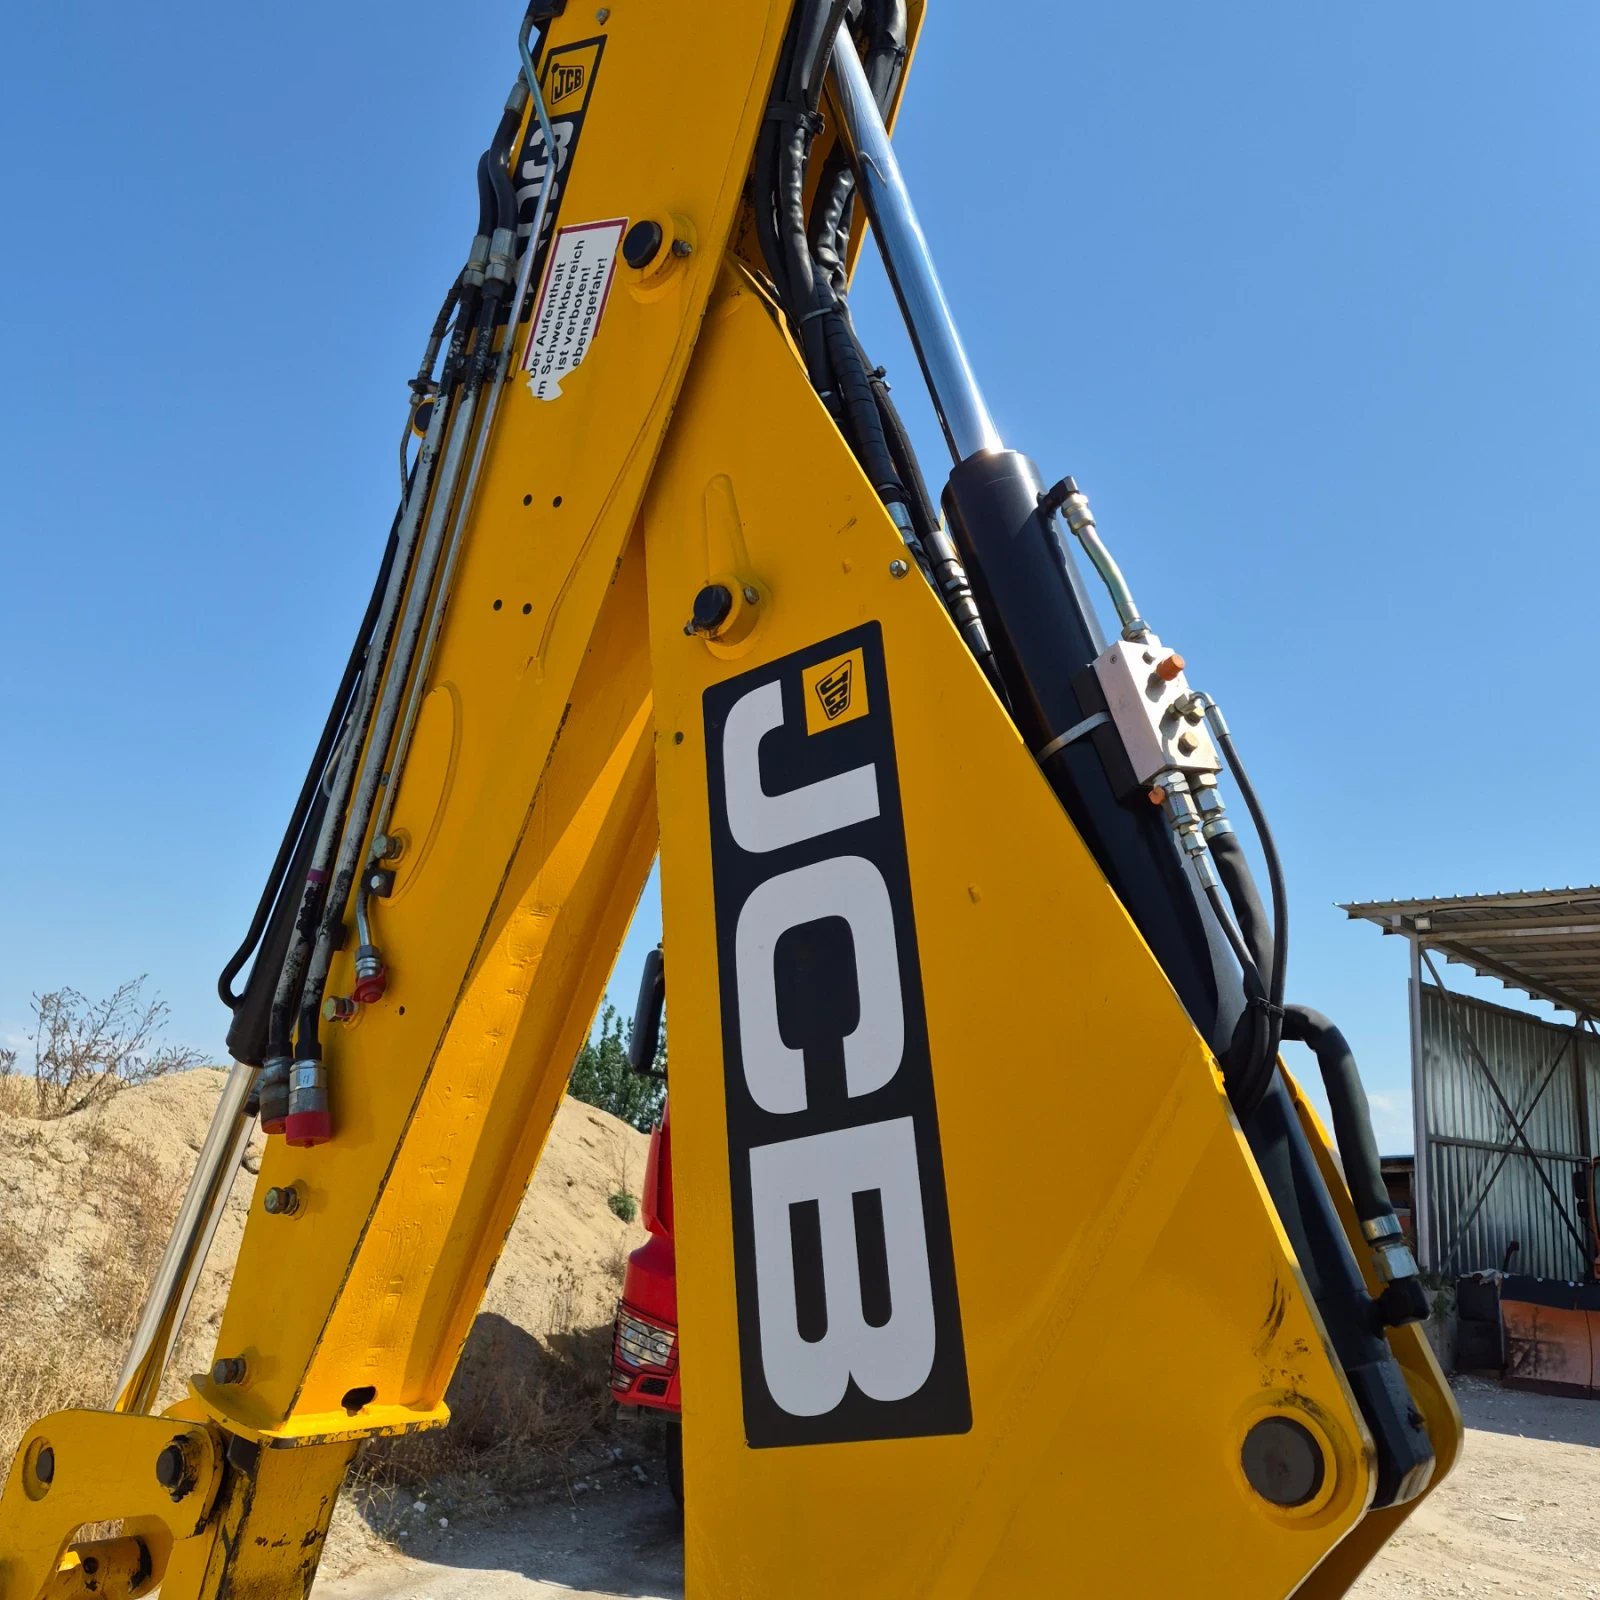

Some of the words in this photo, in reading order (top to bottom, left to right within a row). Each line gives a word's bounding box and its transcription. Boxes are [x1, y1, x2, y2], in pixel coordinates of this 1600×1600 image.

[554, 68, 582, 100] JCB
[536, 262, 566, 347] Aufenthalt
[541, 240, 585, 375] Schwenkbereich
[555, 350, 569, 370] ist
[564, 267, 591, 346] verboten!
[819, 669, 850, 717] JCB
[723, 679, 936, 1417] JCB
